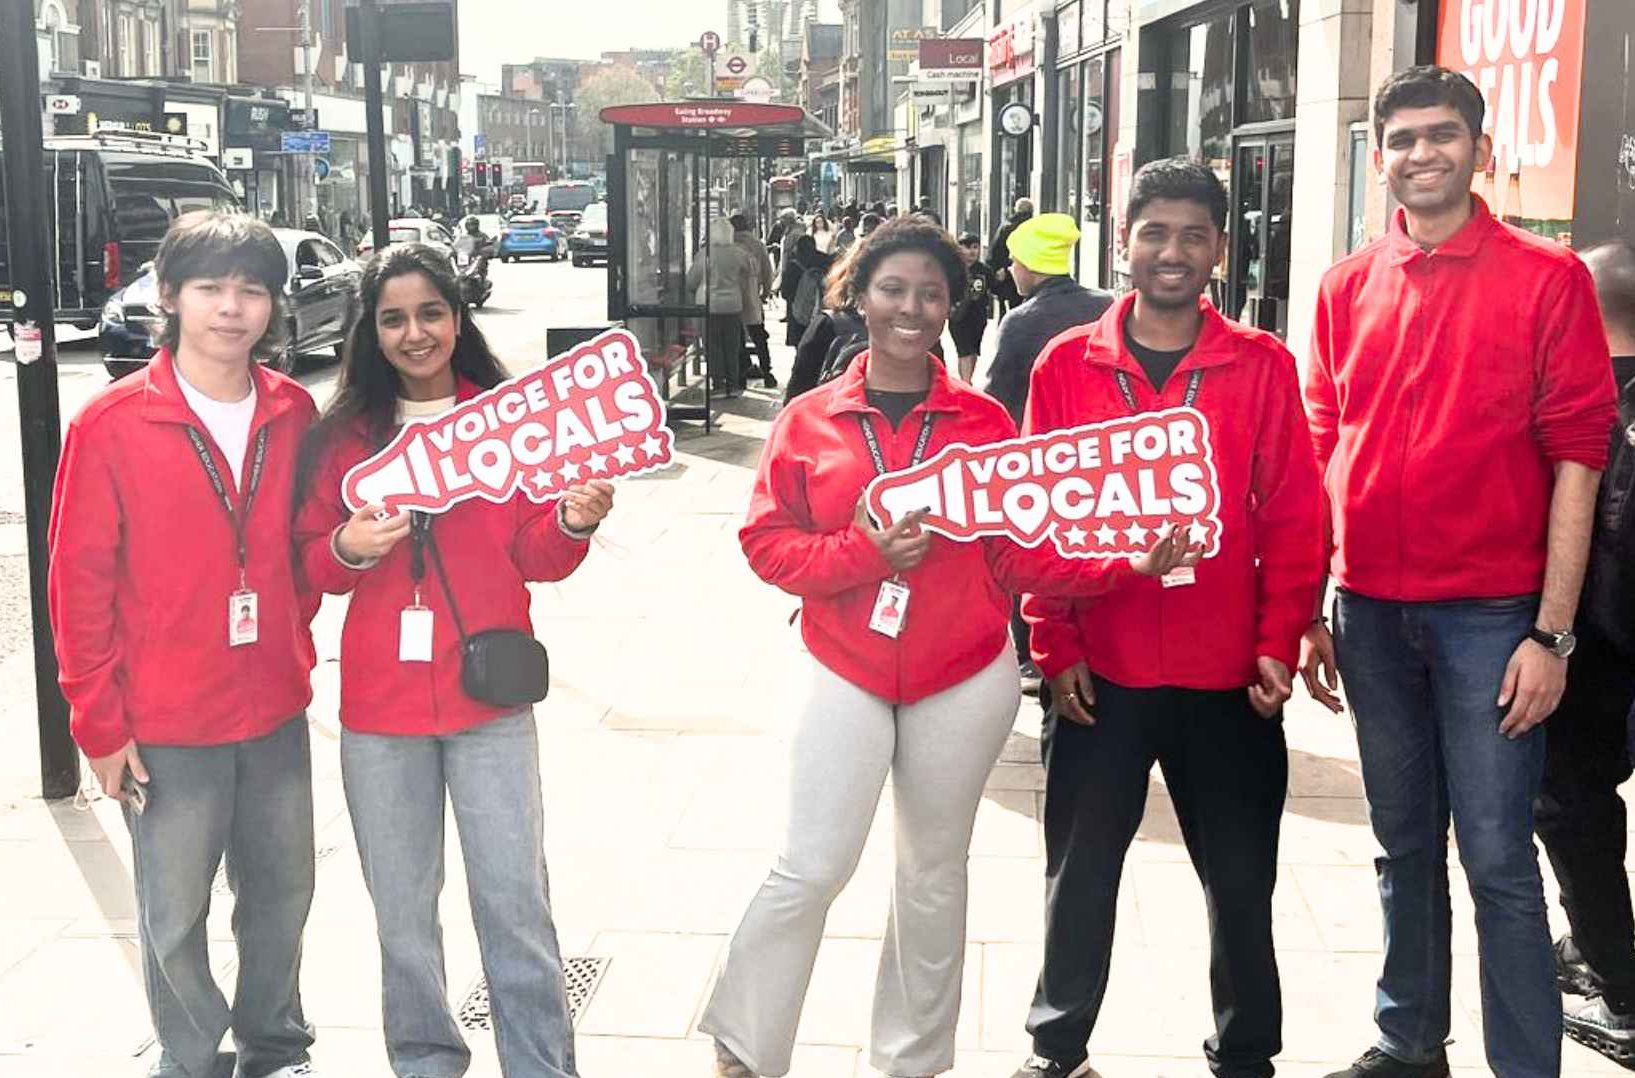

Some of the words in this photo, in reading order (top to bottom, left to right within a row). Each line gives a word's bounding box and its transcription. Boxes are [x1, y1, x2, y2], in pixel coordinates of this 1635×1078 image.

[949, 53, 979, 64] Local
[1460, 0, 1565, 65] GOOD
[674, 107, 696, 116] Ealing
[697, 107, 732, 118] Broadway
[681, 115, 707, 123] Station
[1461, 57, 1559, 168] EALS
[426, 377, 550, 452] VOICE
[551, 341, 635, 401] FOR
[438, 381, 654, 490] LOCALS
[966, 437, 1101, 484] VOICE
[1110, 420, 1199, 465] FOR
[973, 462, 1207, 535] LOCALS
